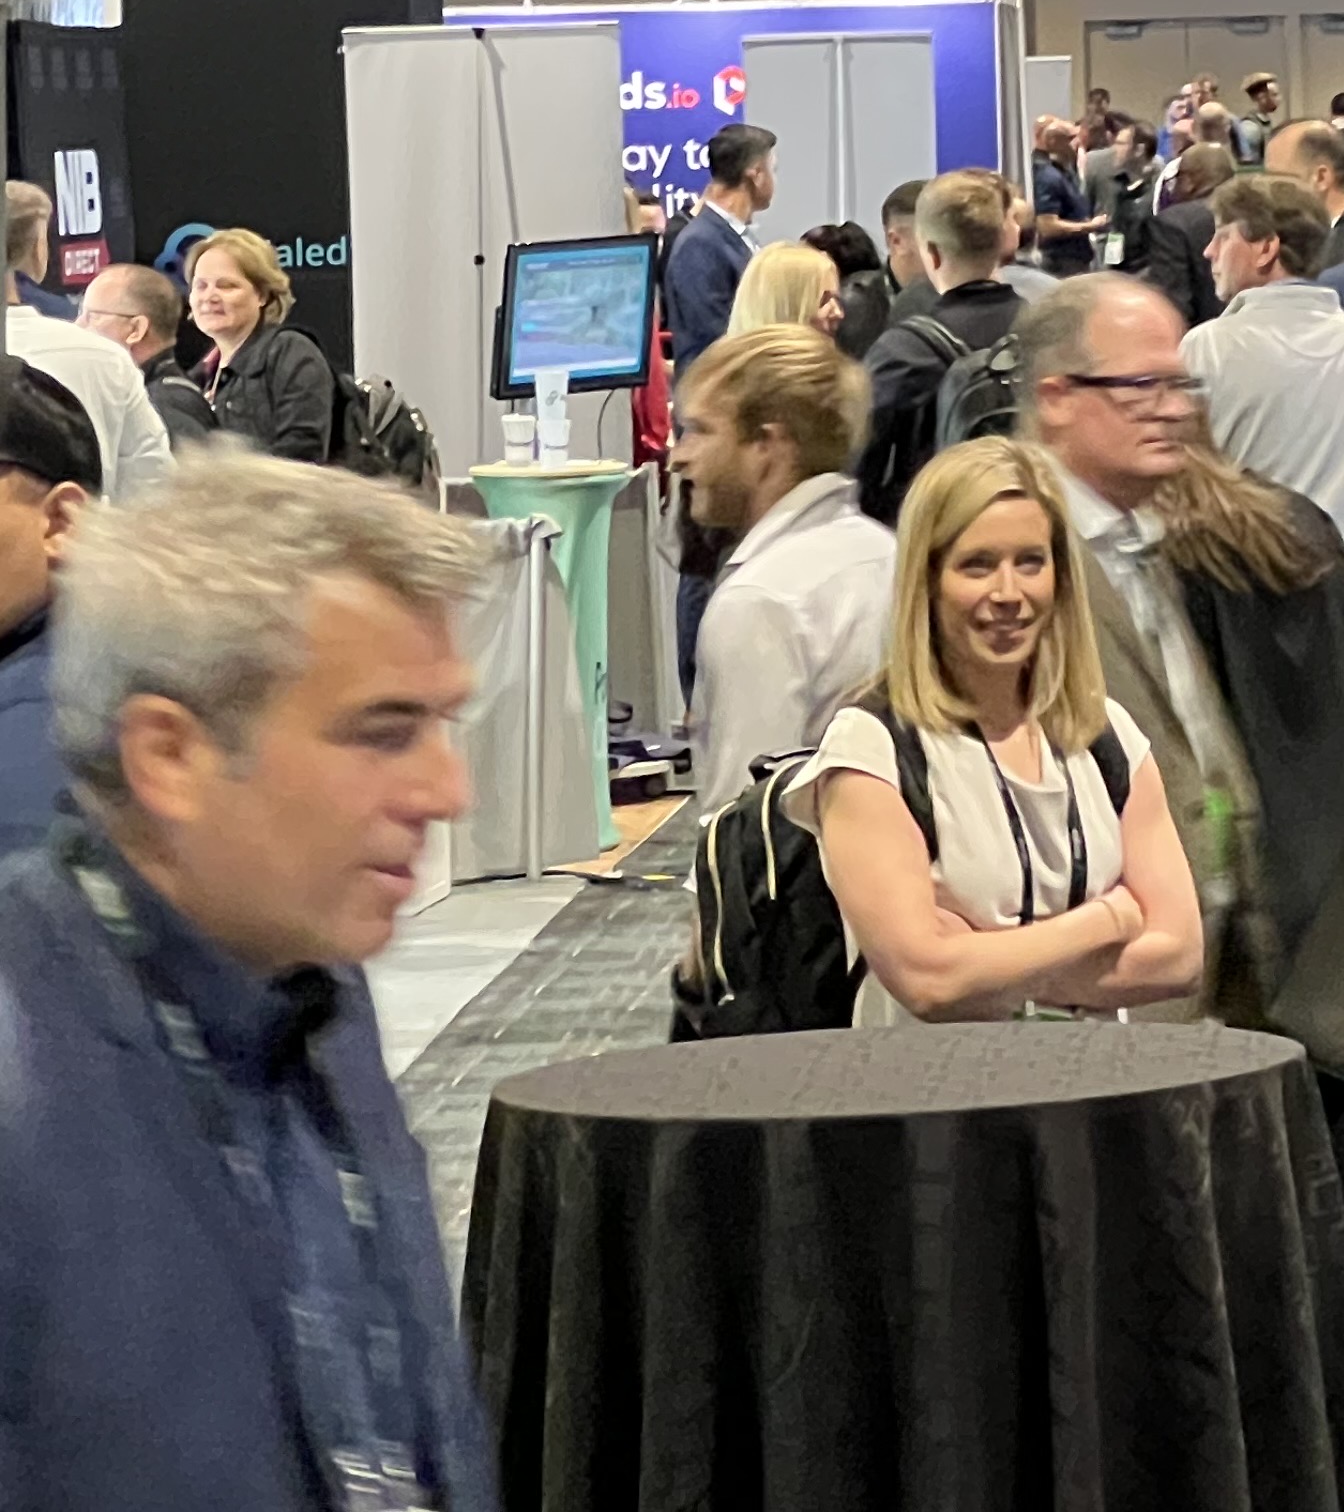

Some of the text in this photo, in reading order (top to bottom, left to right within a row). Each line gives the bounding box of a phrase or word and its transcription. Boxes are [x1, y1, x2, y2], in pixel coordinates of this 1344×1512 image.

[619, 70, 701, 111] ds.io
[621, 141, 673, 178] ay
[274, 234, 347, 267] aled
